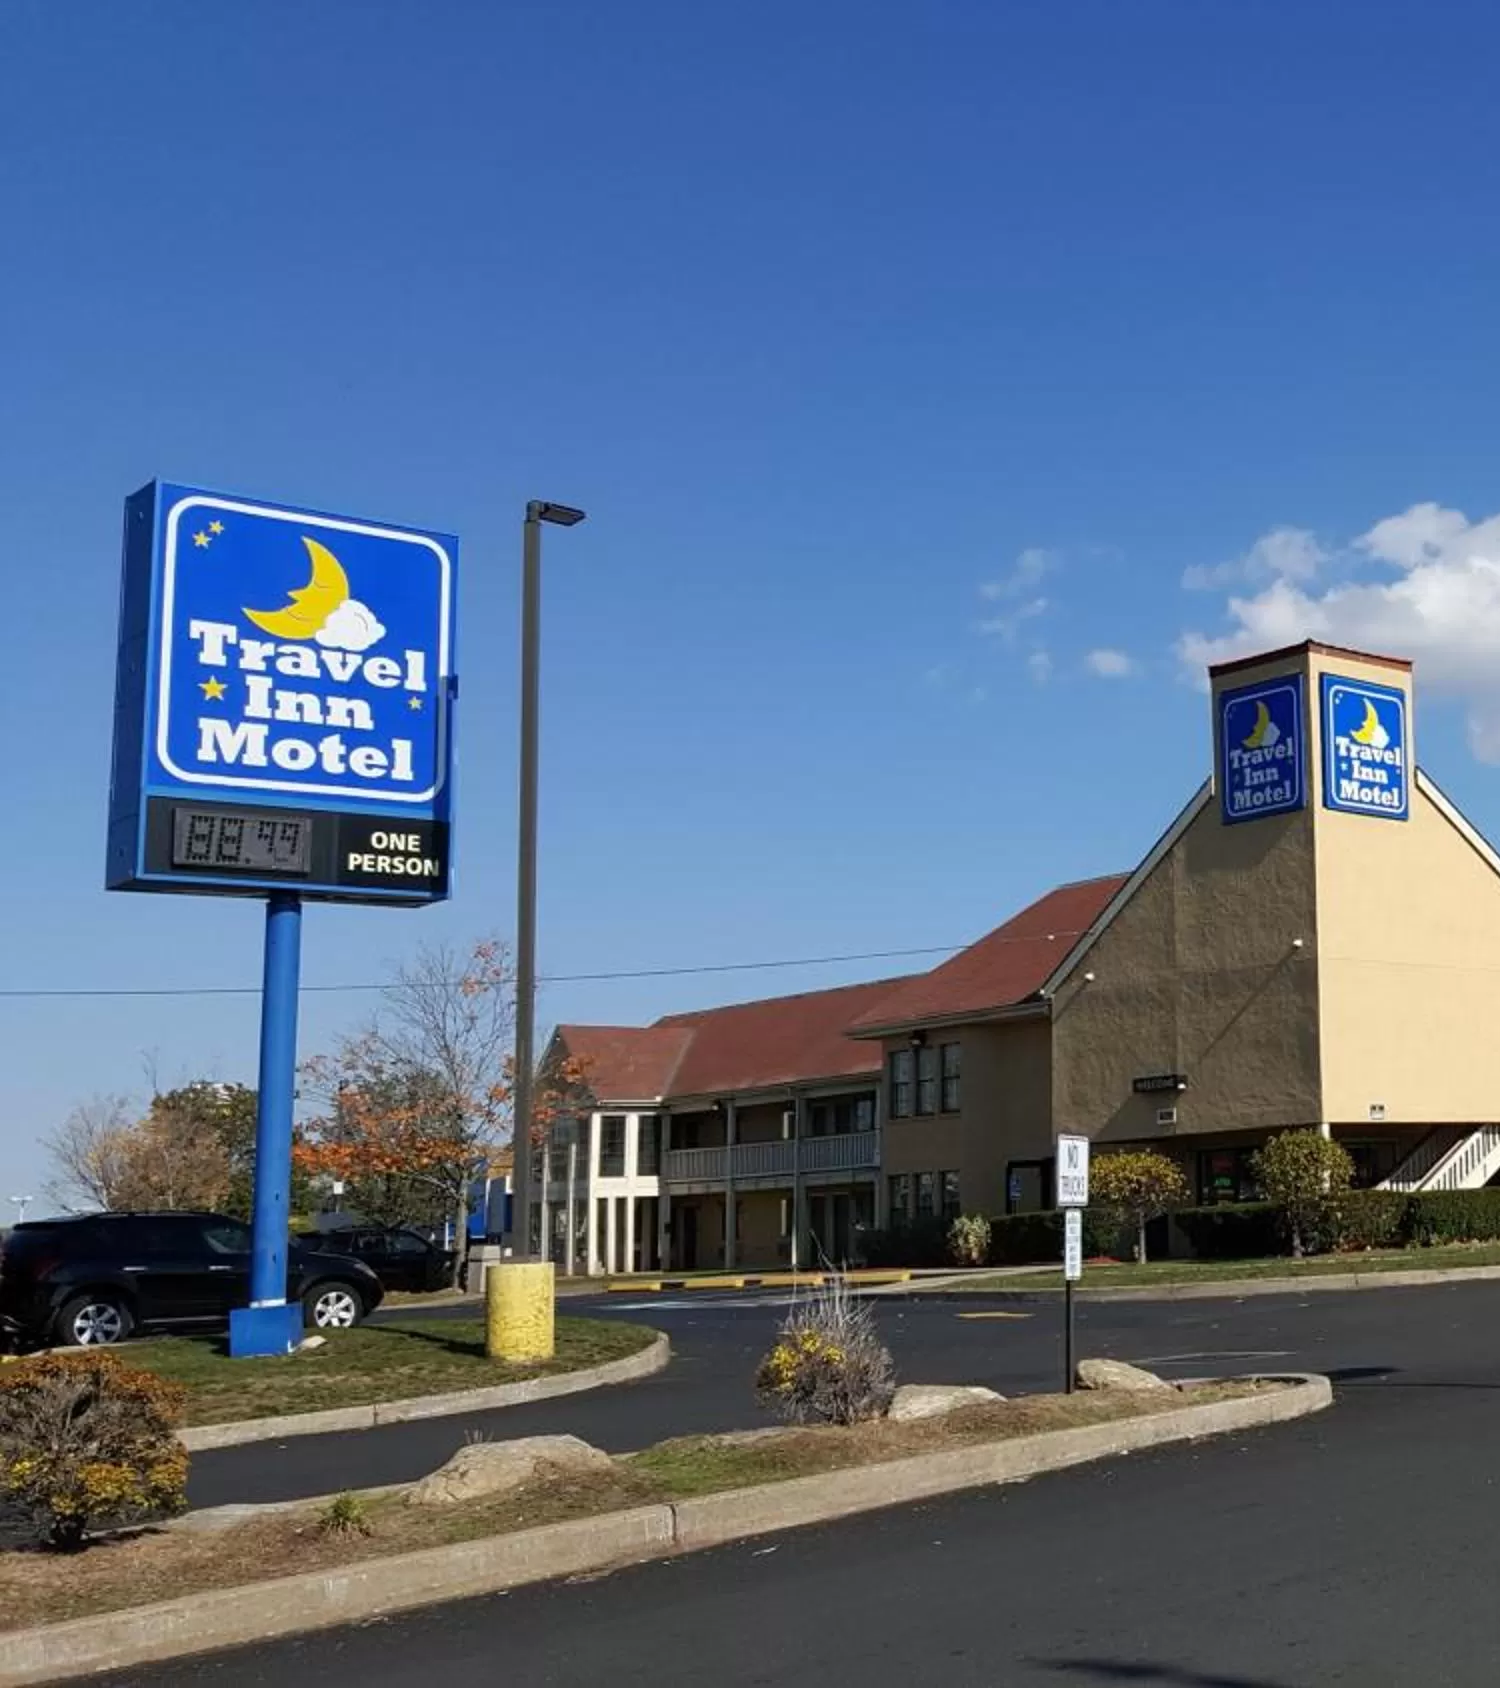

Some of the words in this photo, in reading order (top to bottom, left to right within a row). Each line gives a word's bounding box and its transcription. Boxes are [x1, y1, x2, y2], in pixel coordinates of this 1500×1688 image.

[188, 619, 427, 692] Travel
[244, 675, 374, 730] Inn
[197, 717, 415, 781] Motel
[1229, 737, 1294, 768] Travel
[1336, 736, 1402, 766] Travel
[1244, 766, 1279, 786] Inn
[1351, 760, 1388, 784] Inn
[1233, 780, 1292, 811] Motel
[1340, 780, 1400, 807] Motel
[370, 831, 421, 853] ONE
[347, 852, 440, 877] PERSON
[1067, 1144, 1079, 1169] NO
